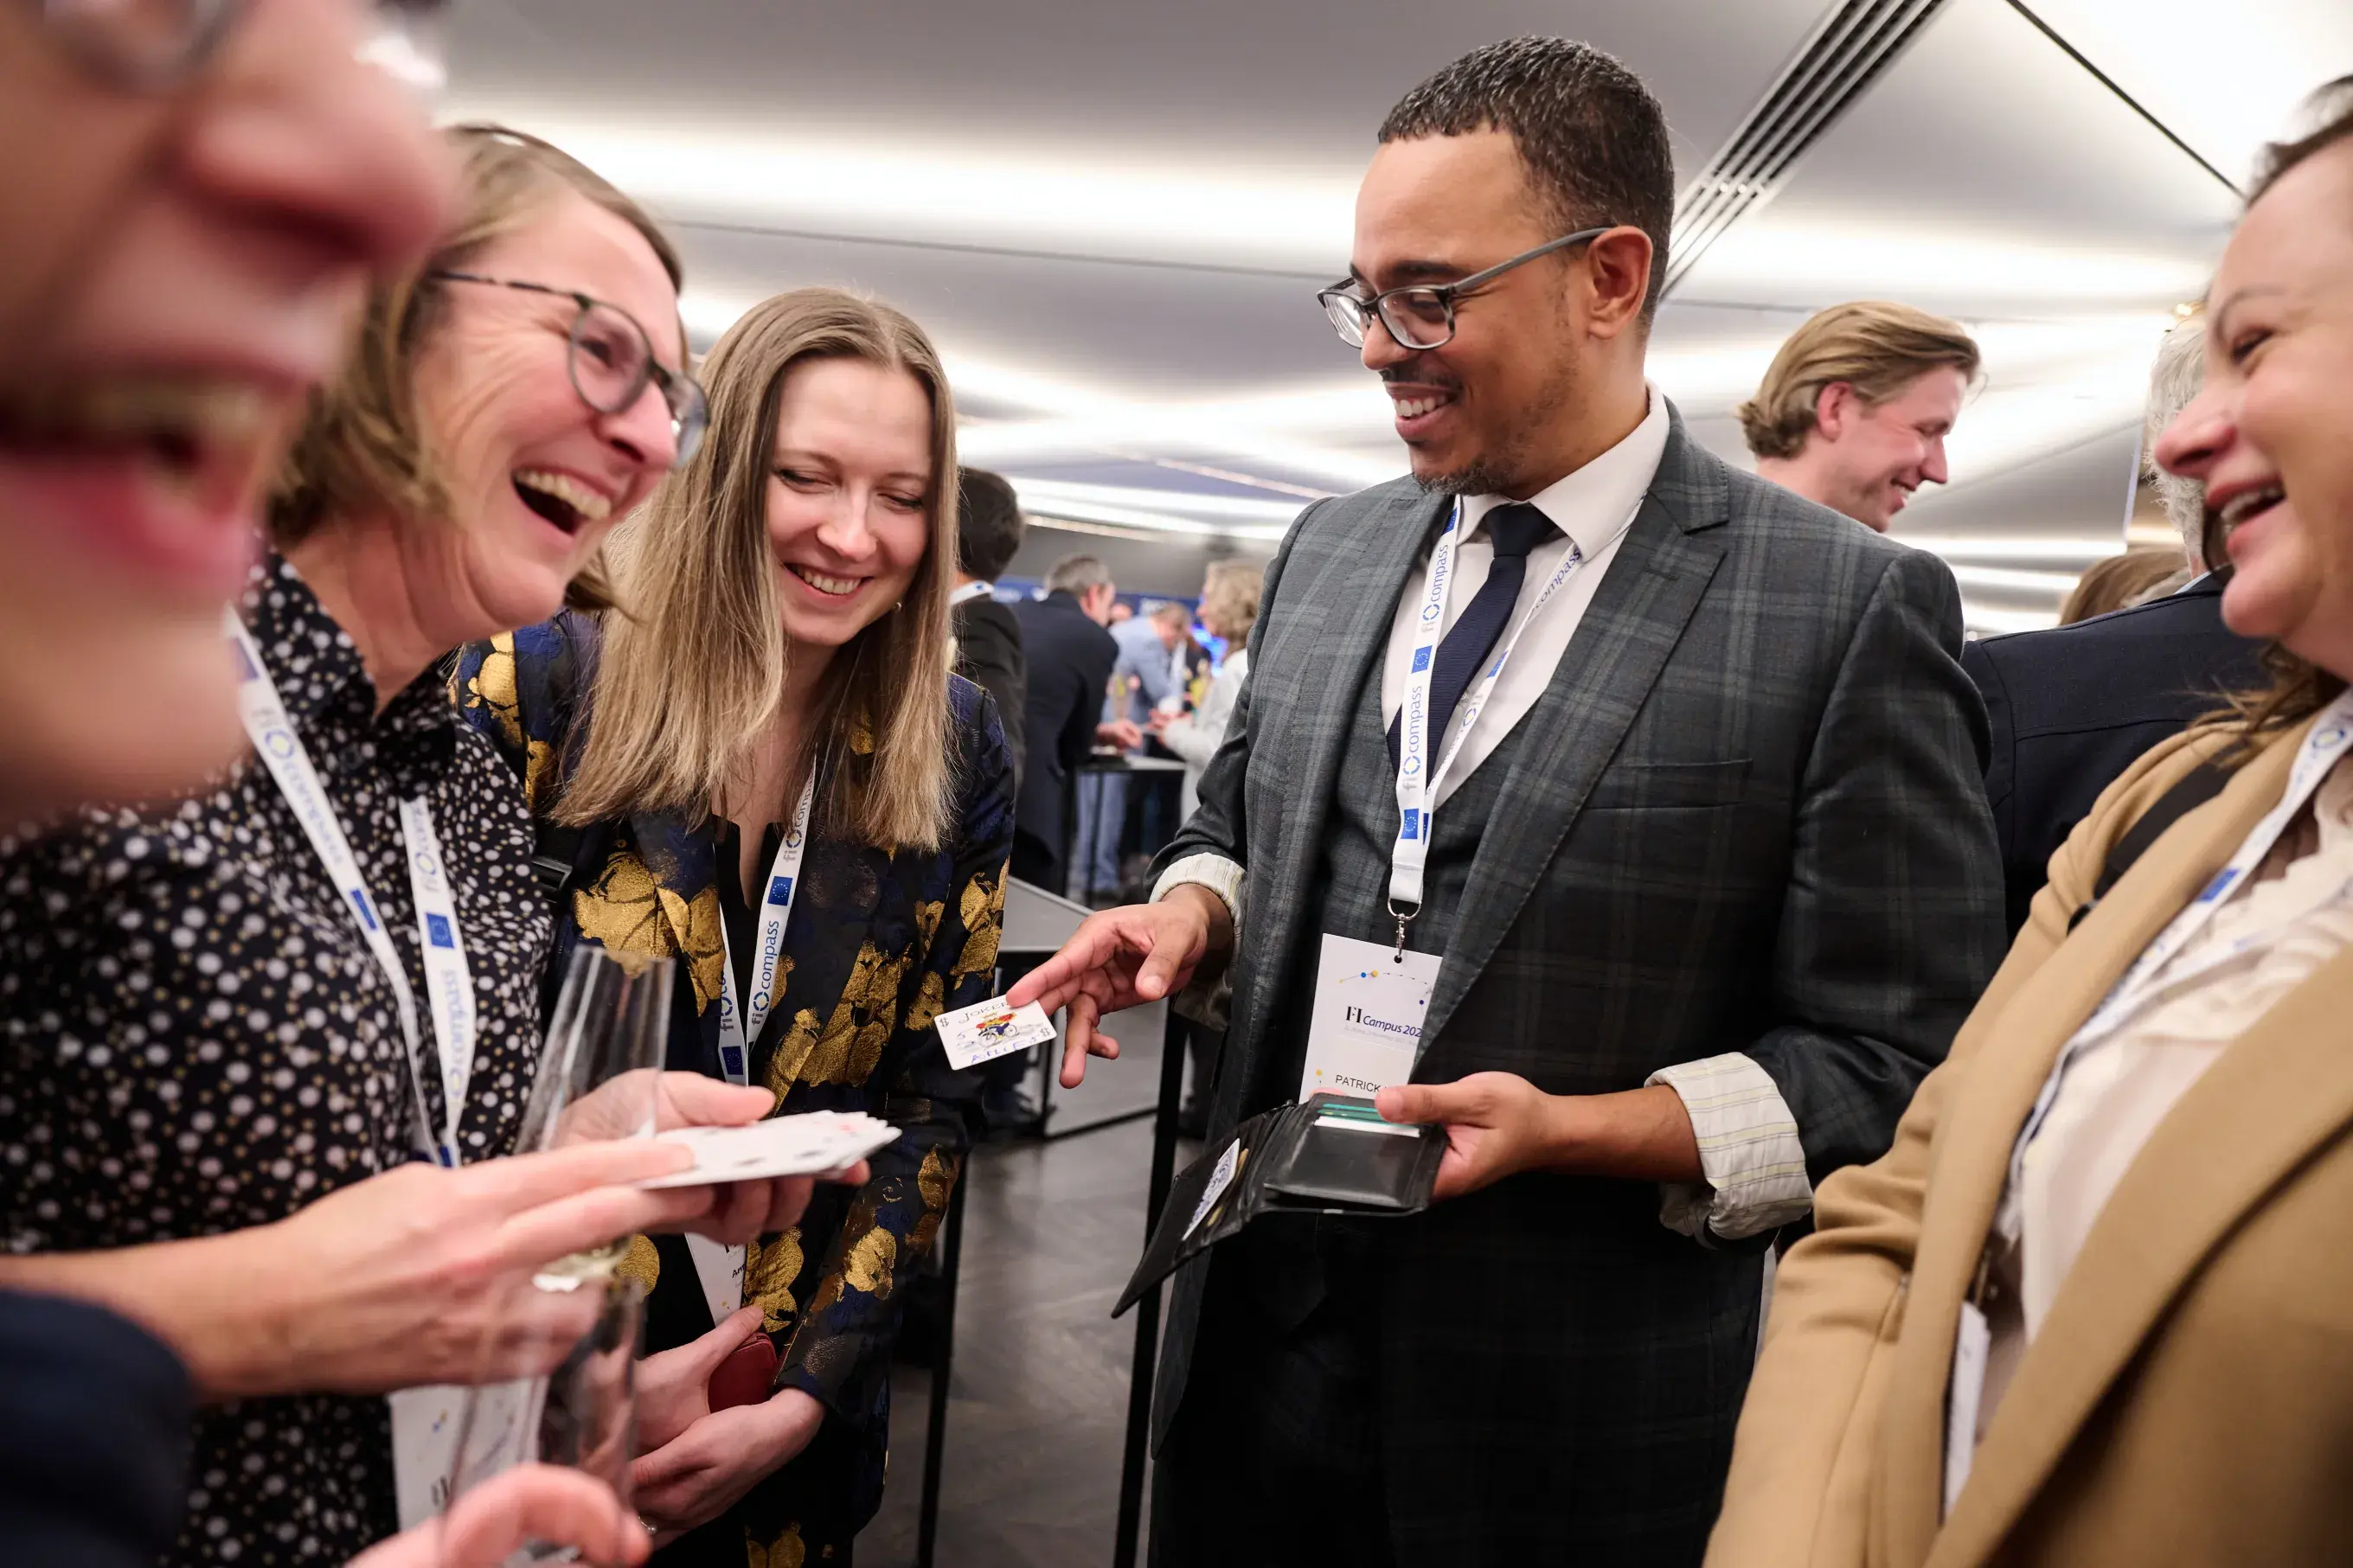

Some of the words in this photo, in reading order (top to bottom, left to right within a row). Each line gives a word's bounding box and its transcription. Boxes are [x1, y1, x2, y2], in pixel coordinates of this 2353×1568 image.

[1430, 544, 1449, 603] compass
[1408, 686, 1424, 753] compass
[761, 920, 779, 990] compass
[1362, 1015, 1403, 1034] Campus
[1335, 1074, 1382, 1093] PATRICK
